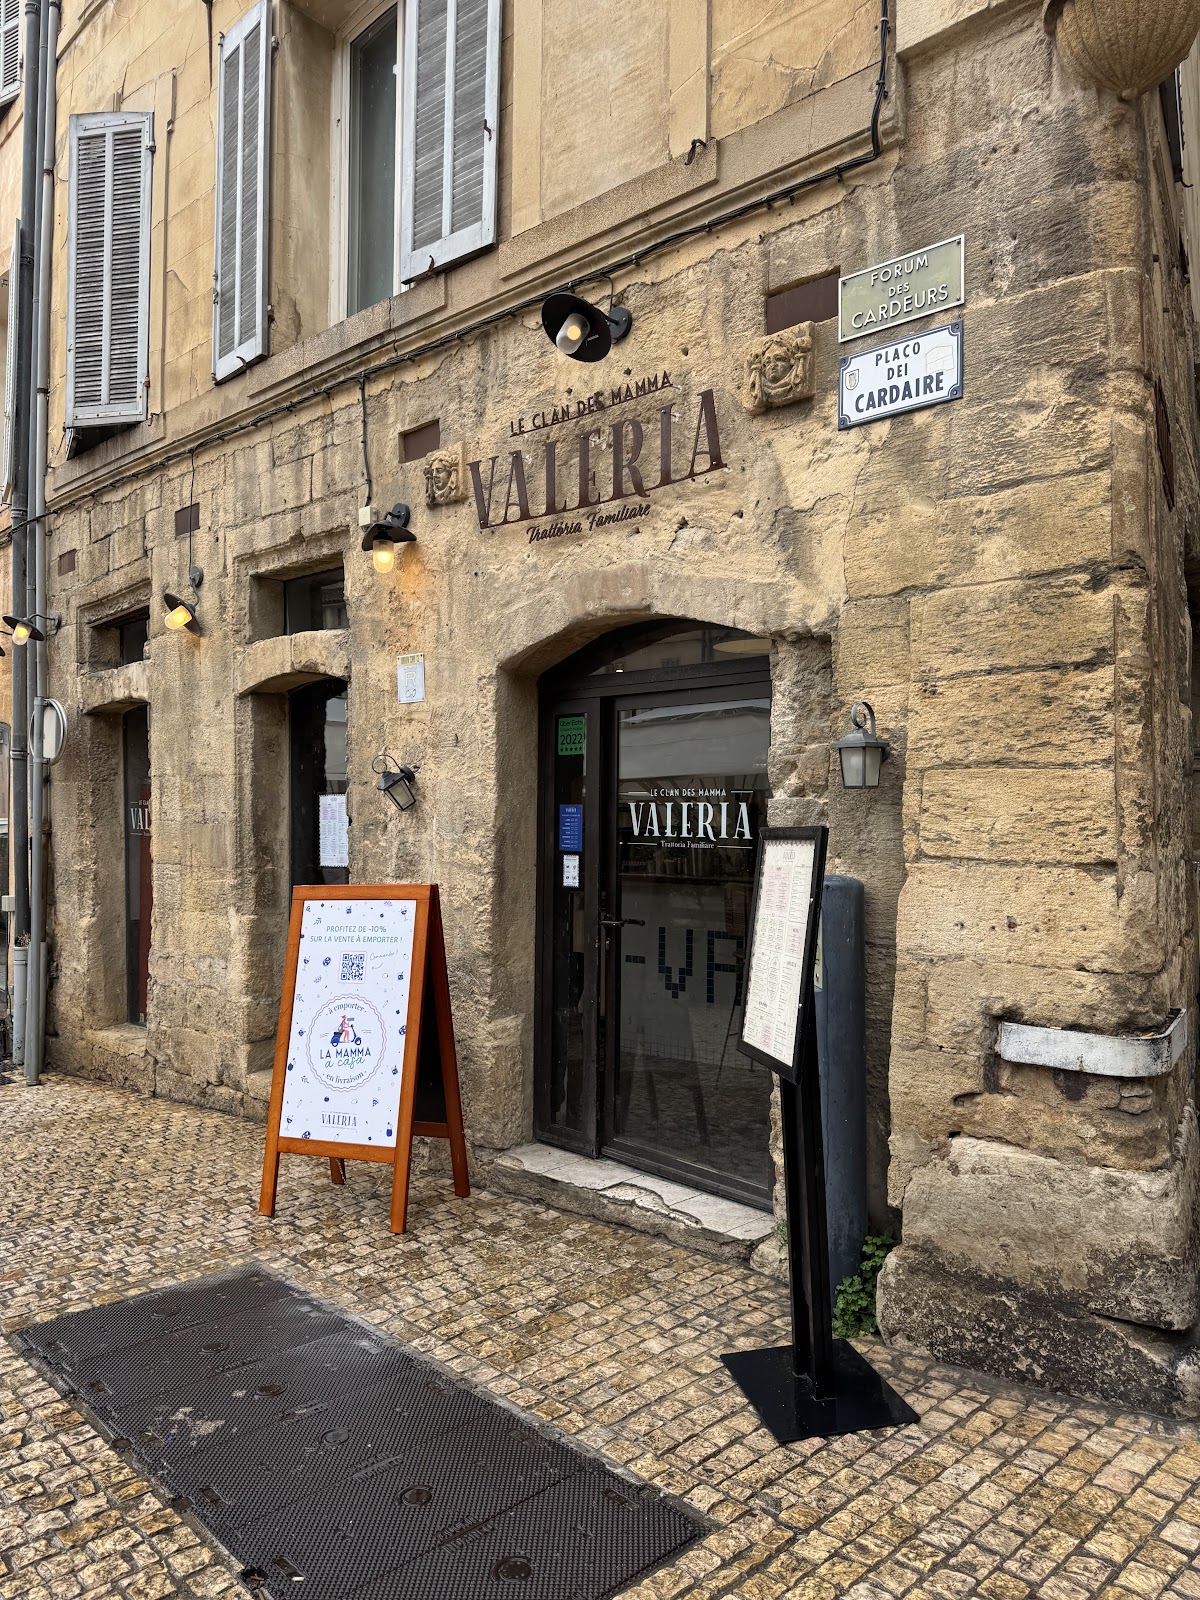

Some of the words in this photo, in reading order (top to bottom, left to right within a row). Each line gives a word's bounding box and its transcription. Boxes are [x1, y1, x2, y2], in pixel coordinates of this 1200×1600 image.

[870, 254, 929, 287] FORUM
[888, 282, 910, 298] DES
[851, 284, 949, 330] CARDEURS
[875, 341, 920, 367] PLAÇO
[887, 363, 908, 381] DEI
[855, 371, 944, 413] CARDAIRE
[510, 418, 525, 435] LE
[532, 404, 570, 430] CLAN
[576, 390, 605, 416] DES
[611, 370, 673, 405] MAMMA
[466, 388, 727, 529] VALERIA
[587, 503, 651, 532] Familiare
[560, 733, 583, 746] 2022
[650, 789, 658, 797] LE
[660, 788, 680, 797] CLAN
[682, 788, 696, 797] DES
[698, 788, 727, 797] MAMMA
[628, 802, 753, 841] VALERIA
[660, 840, 686, 848] Trattoria
[687, 840, 715, 850] Familiare
[326, 925, 357, 933] PROFITEZ
[358, 925, 367, 933] DE
[368, 925, 387, 933] -10%
[310, 935, 322, 943] SUR
[324, 935, 332, 943] LA
[333, 935, 354, 943] VENTE
[356, 934, 361, 943] À
[362, 935, 399, 943] EMPORTER
[333, 1002, 365, 1012] emporter
[320, 1049, 331, 1059] LA
[335, 1047, 371, 1059] MAMMA
[325, 1060, 334, 1069] a
[326, 1073, 334, 1082] en
[335, 1071, 364, 1084] livraison
[321, 1113, 357, 1127] VALERIA
